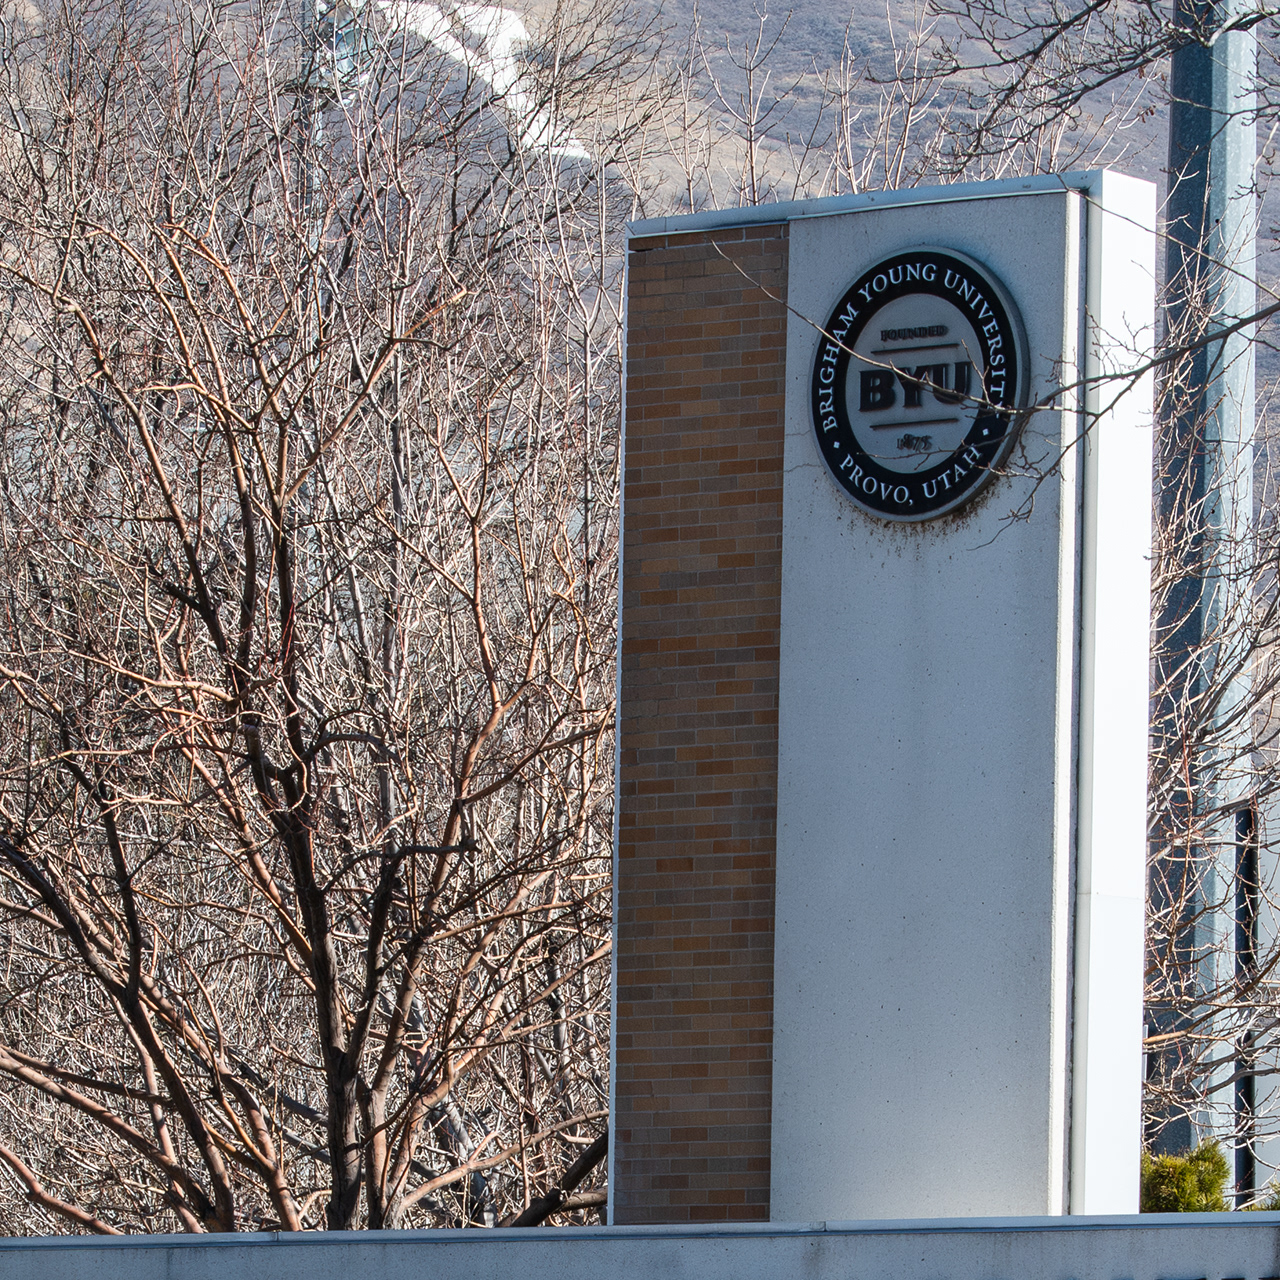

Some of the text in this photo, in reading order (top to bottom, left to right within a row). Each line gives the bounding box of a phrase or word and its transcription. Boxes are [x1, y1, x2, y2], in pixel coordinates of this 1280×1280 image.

[819, 302, 859, 433] BRIGHAM
[857, 263, 938, 303] YOUNG
[880, 324, 948, 342] FOUNDED
[858, 361, 972, 412] BYU
[839, 443, 983, 506] PROVO, UTAH
